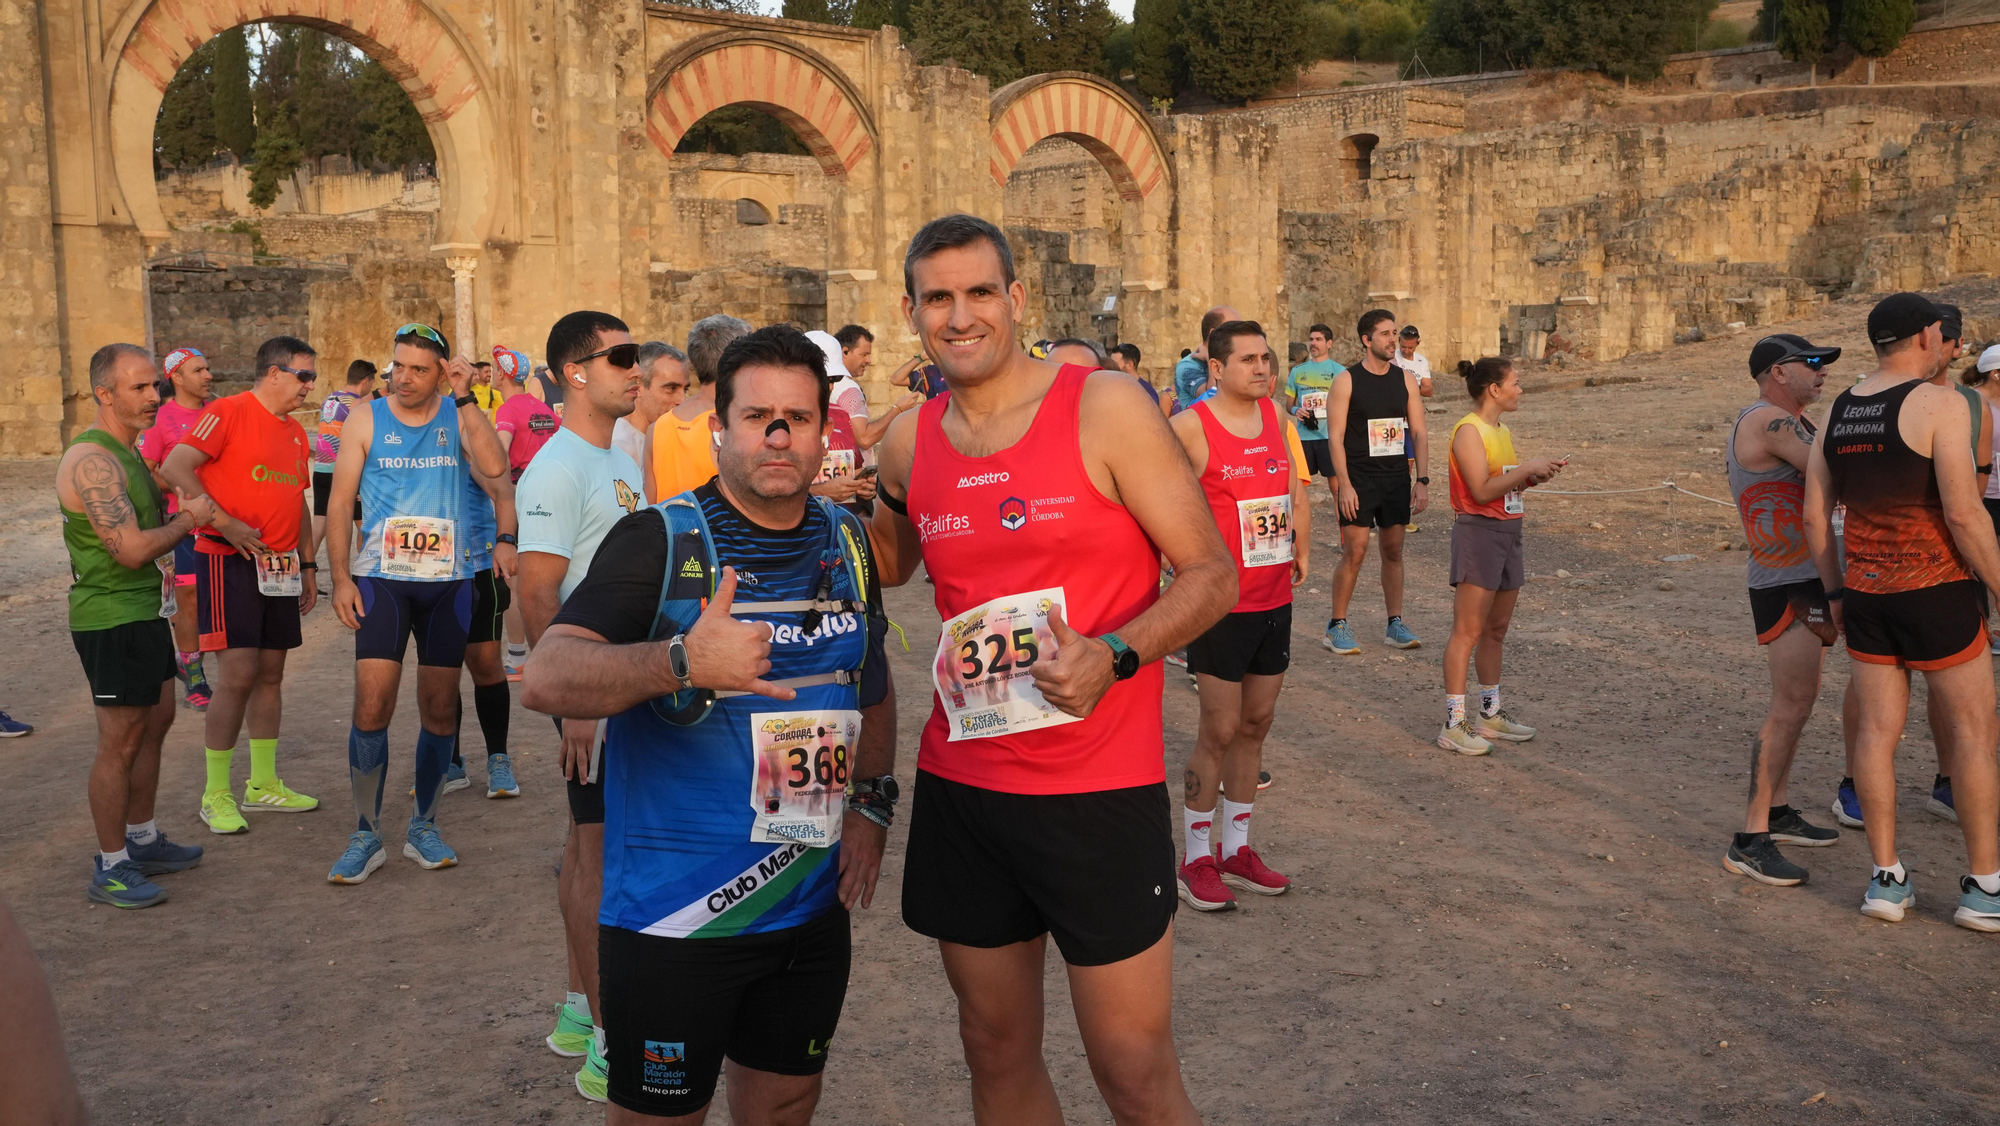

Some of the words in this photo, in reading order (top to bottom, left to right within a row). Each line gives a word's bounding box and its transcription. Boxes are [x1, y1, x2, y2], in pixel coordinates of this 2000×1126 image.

[1307, 398, 1323, 408] 351
[1842, 402, 1887, 419] LEONES
[1382, 427, 1396, 439] 30
[1832, 422, 1885, 437] CARMONA
[384, 431, 402, 443] als
[1878, 444, 1884, 452] D
[378, 455, 458, 469] TROTASIERRA
[252, 464, 298, 487] Orona
[823, 466, 847, 480] 561
[1230, 466, 1254, 476] califas
[956, 471, 1010, 488] Mosttro
[1744, 484, 1778, 500] fuerza
[1788, 486, 1798, 494] es
[1030, 495, 1075, 506] UNIVERSIDAD
[926, 513, 970, 535] califas
[1031, 512, 1064, 522] CÓRDOBA
[1257, 512, 1287, 536] 334
[400, 531, 440, 551] 102
[266, 556, 291, 572] 117
[961, 627, 1039, 680] 325
[788, 744, 848, 788] 368
[707, 875, 757, 913] Club
[757, 843, 807, 881] Mara
[644, 1061, 667, 1070] Club
[645, 1068, 686, 1078] Maratón
[645, 1075, 682, 1085] Lucena
